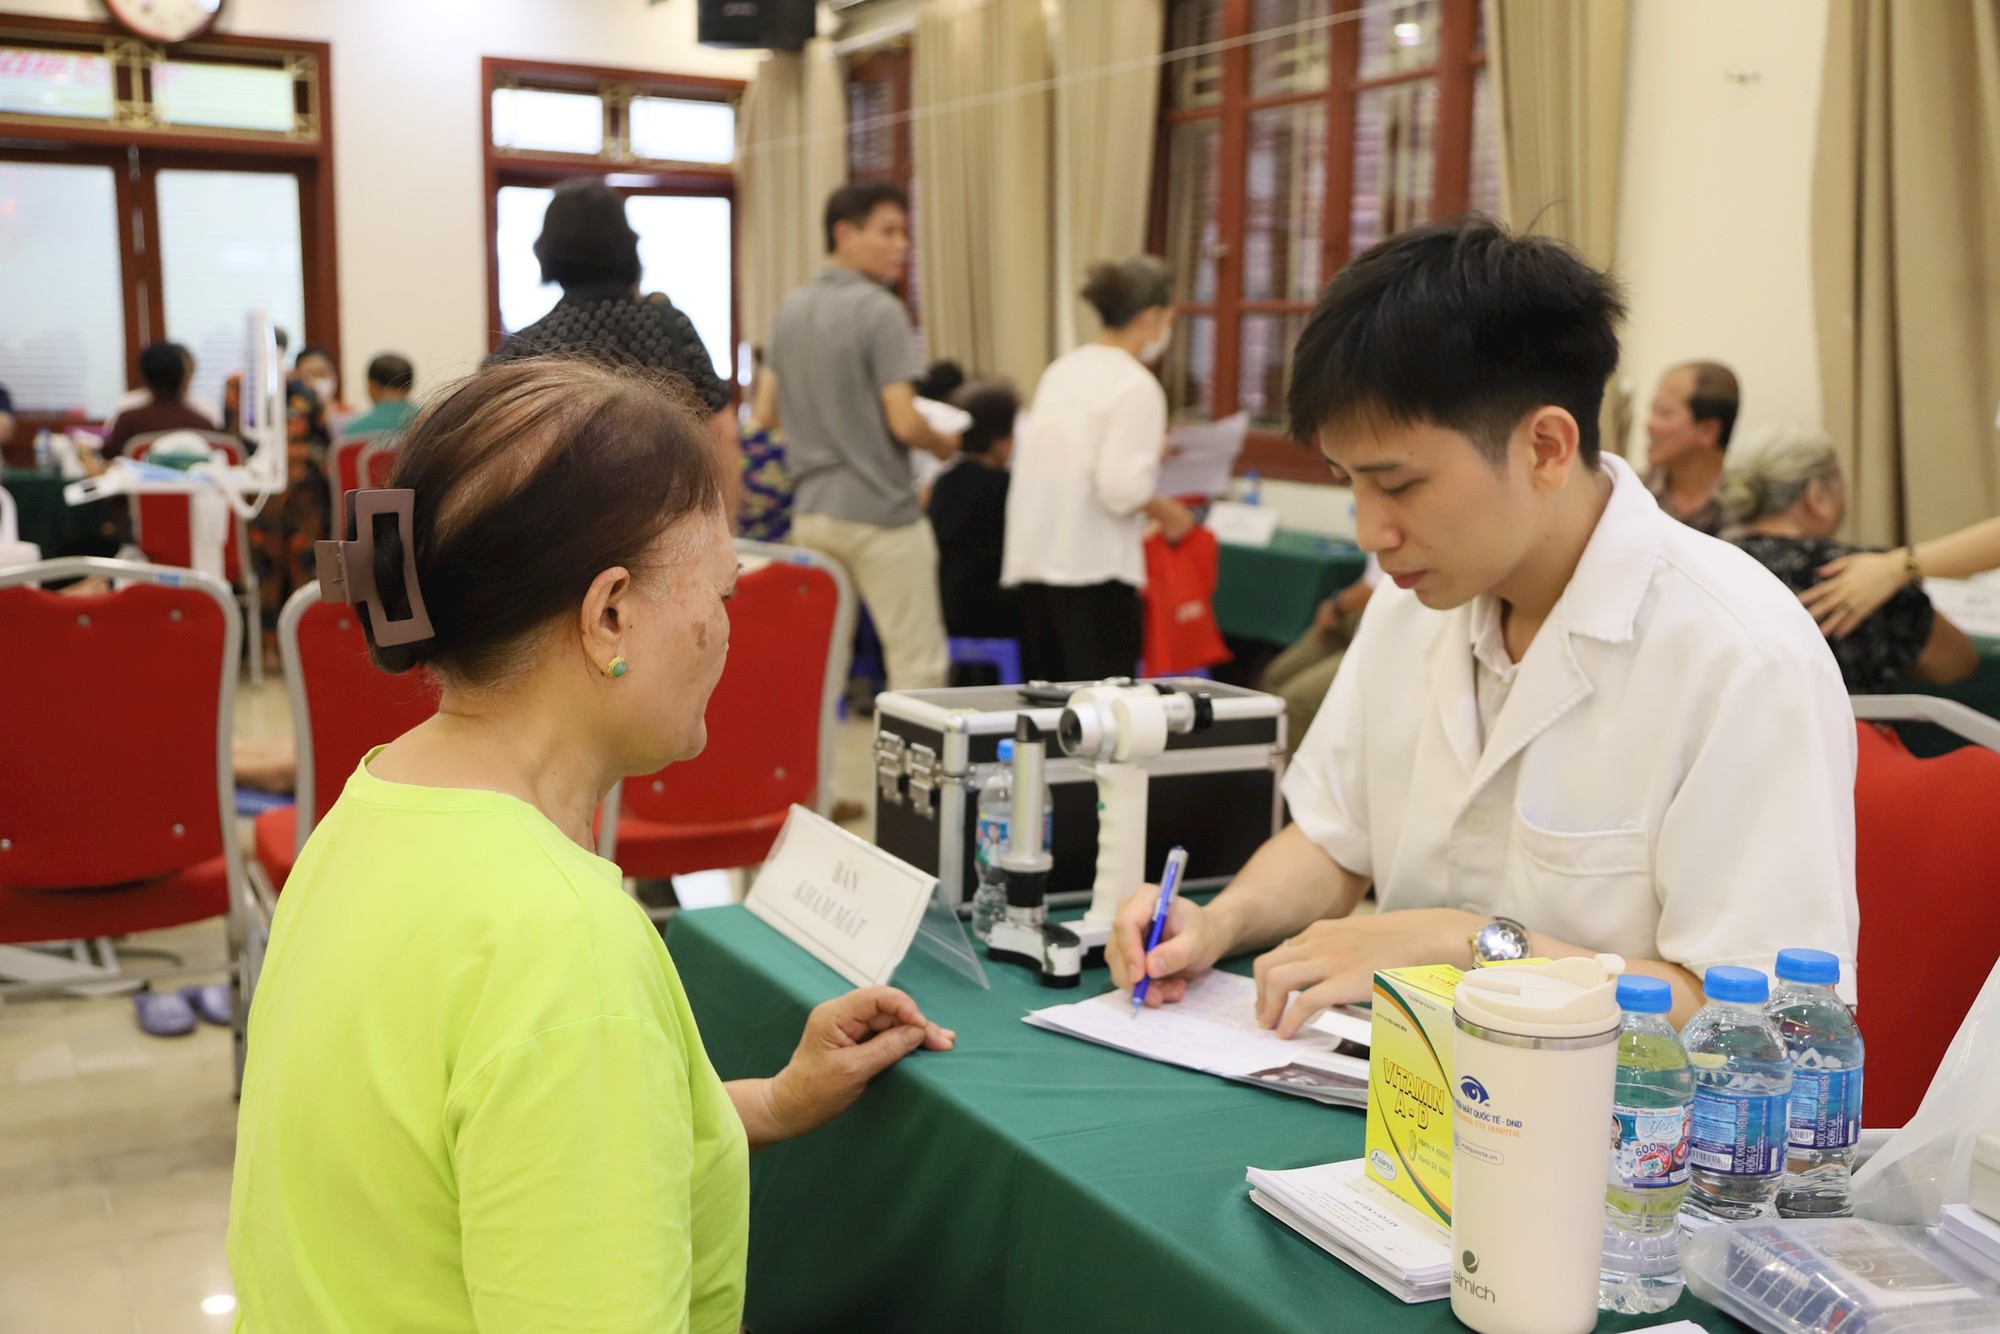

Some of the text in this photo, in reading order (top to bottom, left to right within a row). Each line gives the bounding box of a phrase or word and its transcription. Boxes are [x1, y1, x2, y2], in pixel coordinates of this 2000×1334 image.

[1383, 1057, 1445, 1116] VITAMIN
[1394, 1092, 1406, 1119] A
[1417, 1105, 1429, 1130] D
[1635, 1142, 1657, 1158] 600
[1453, 1270, 1496, 1304] elmich
